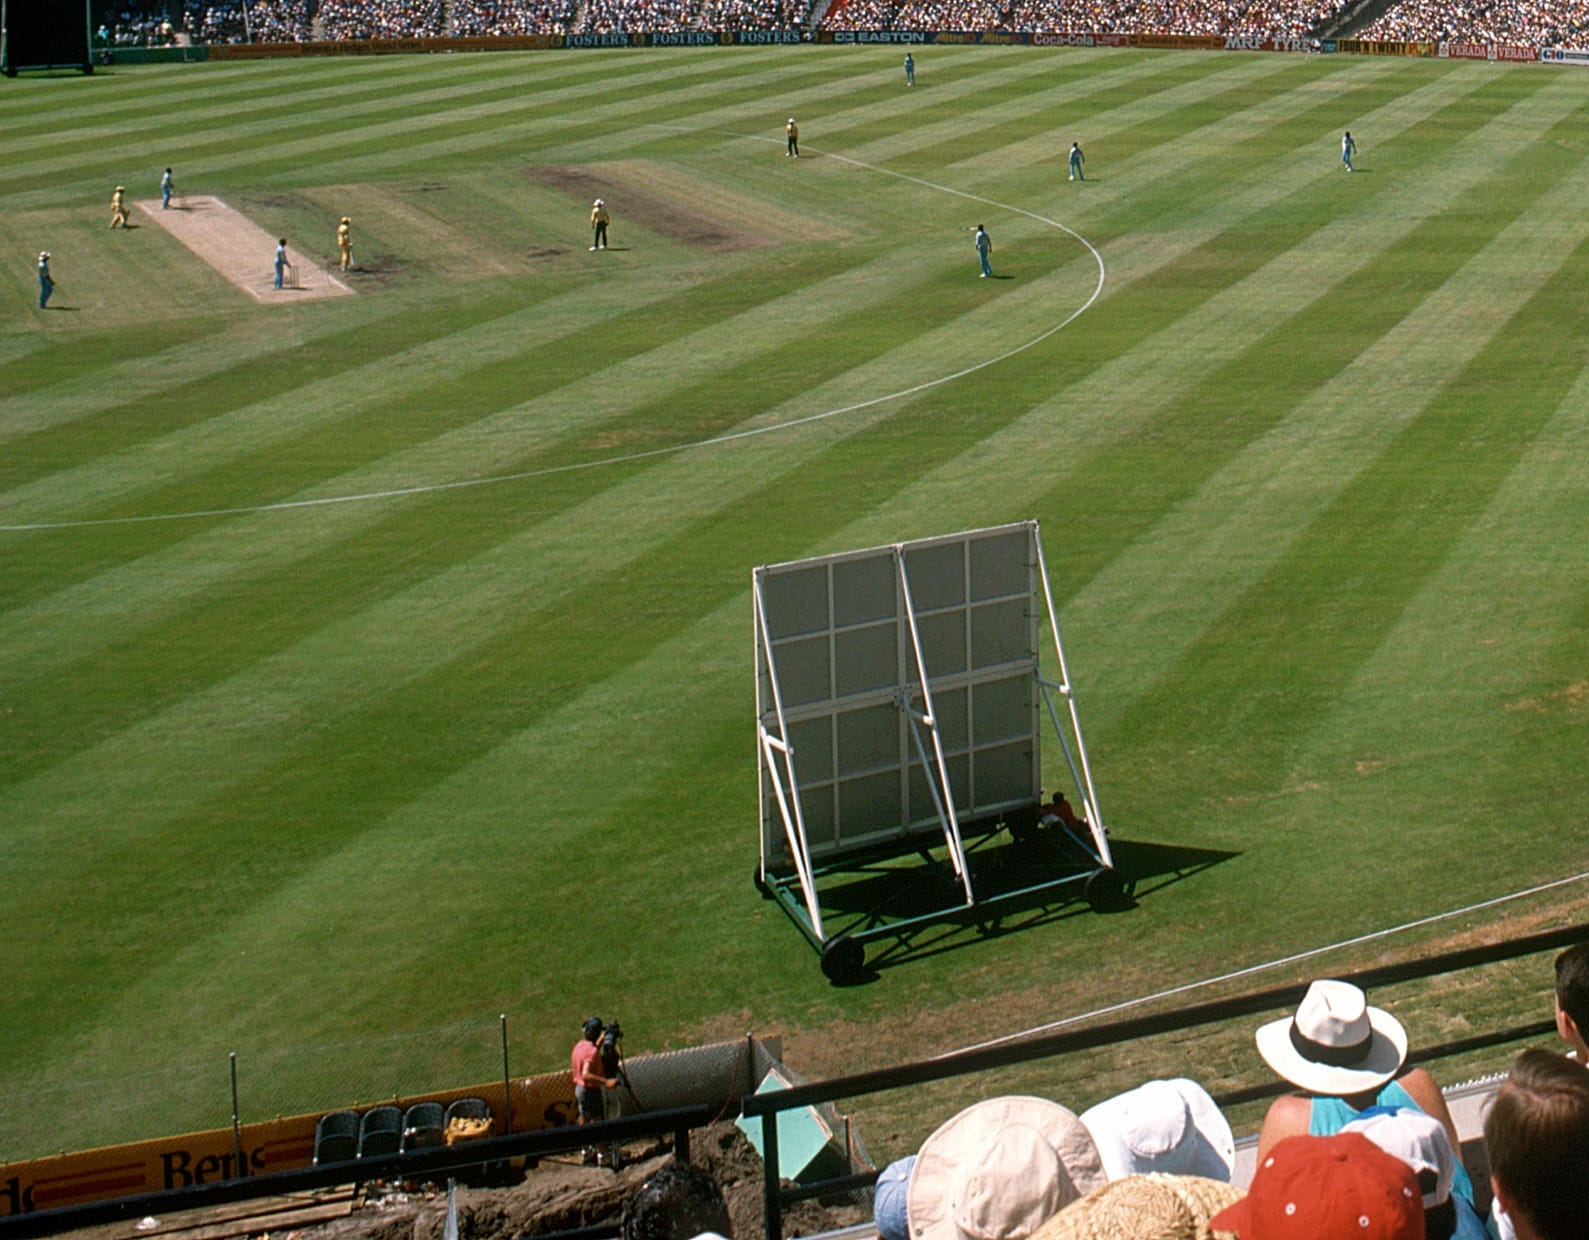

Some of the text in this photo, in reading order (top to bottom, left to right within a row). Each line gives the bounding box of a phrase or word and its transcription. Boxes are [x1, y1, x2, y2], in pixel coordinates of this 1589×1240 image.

[858, 32, 925, 42] EASTON
[1034, 33, 1094, 46] Coca-Cola
[1224, 36, 1267, 50] MRF
[1450, 44, 1487, 57] VERADA
[1500, 46, 1535, 59] VERADA
